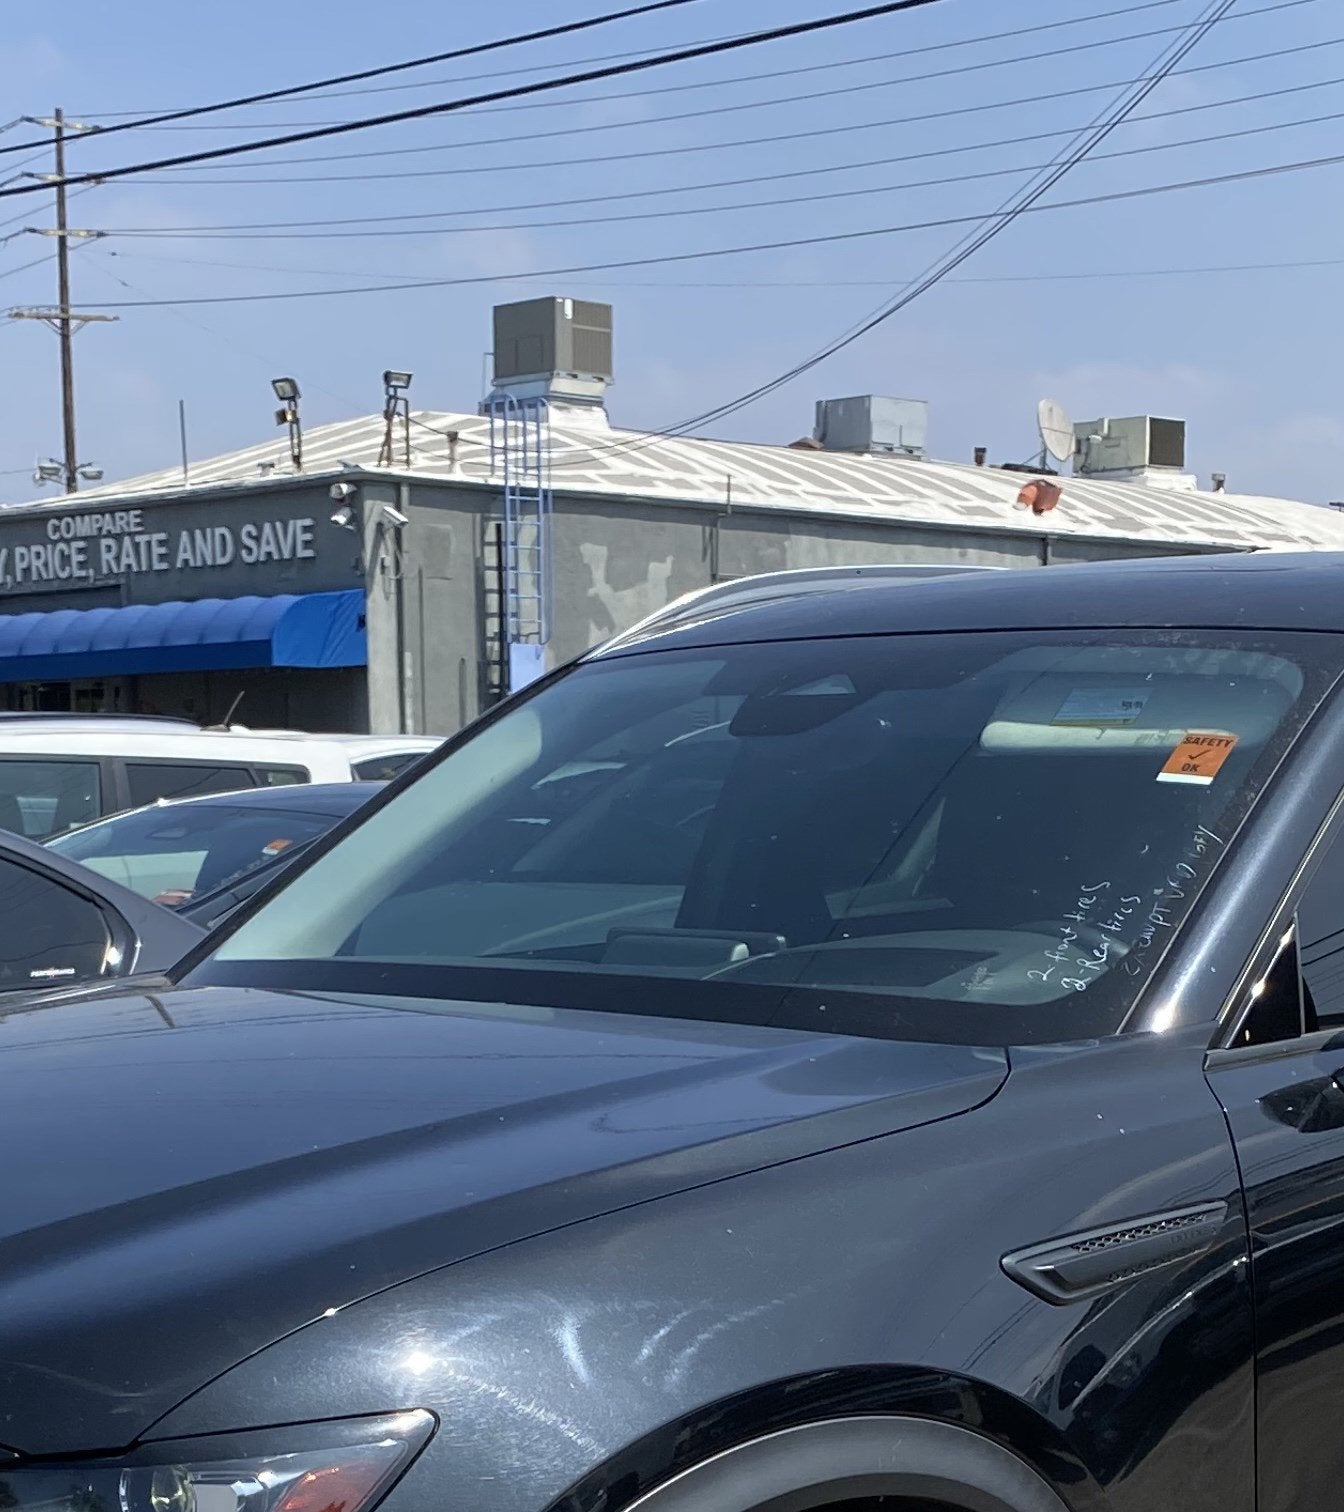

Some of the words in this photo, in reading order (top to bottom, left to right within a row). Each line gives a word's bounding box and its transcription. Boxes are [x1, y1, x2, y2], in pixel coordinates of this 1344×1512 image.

[46, 509, 144, 541] COMPARE
[14, 540, 96, 584] PRICE,
[101, 532, 170, 575] RATE
[176, 526, 234, 569] AND
[240, 518, 316, 565] SAVE
[1182, 735, 1234, 748] SAFETY
[1181, 762, 1201, 773] OK
[1063, 880, 1111, 923] tires
